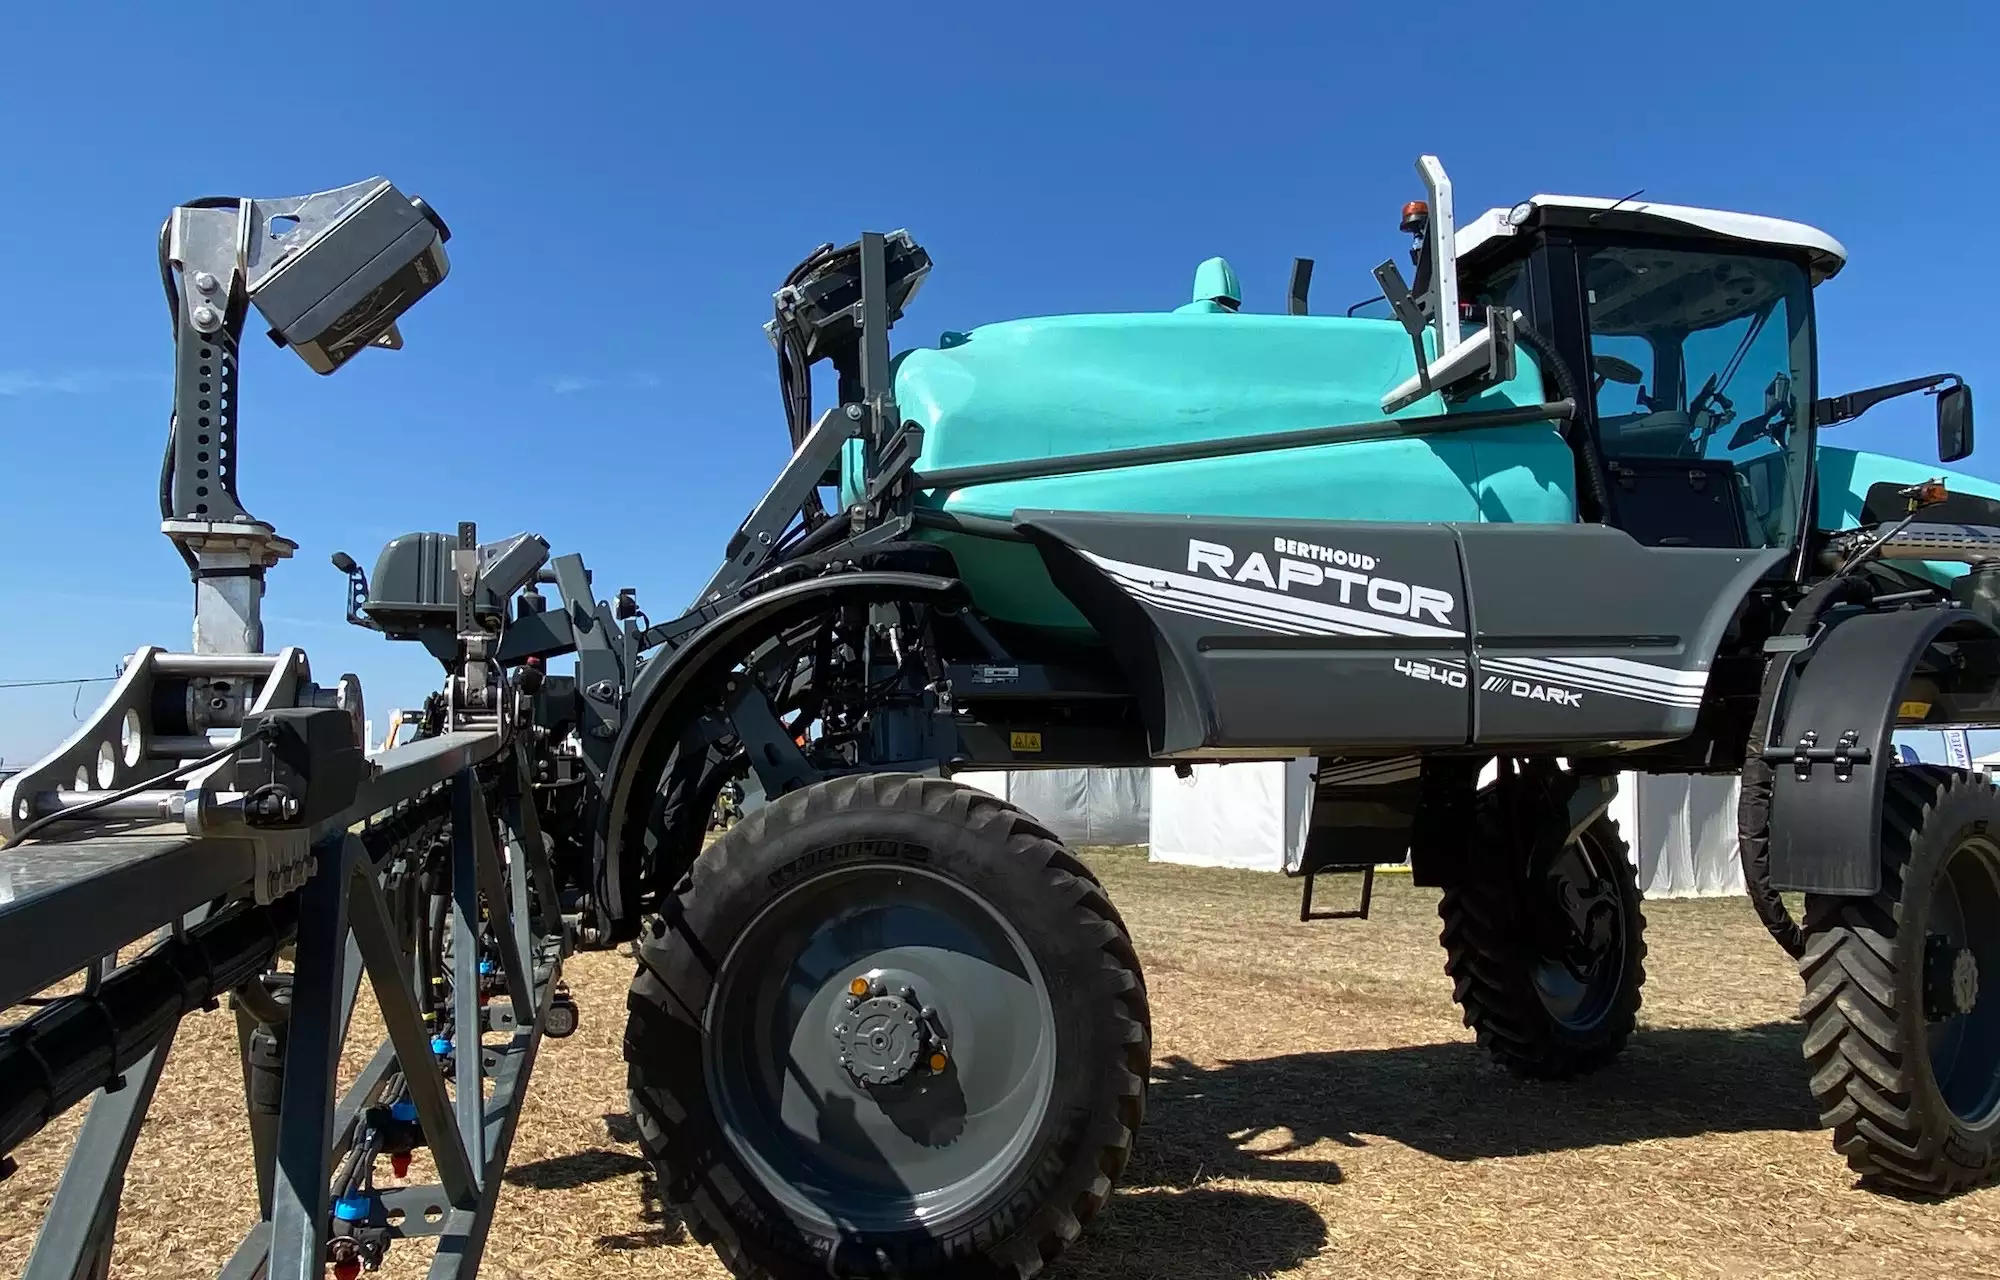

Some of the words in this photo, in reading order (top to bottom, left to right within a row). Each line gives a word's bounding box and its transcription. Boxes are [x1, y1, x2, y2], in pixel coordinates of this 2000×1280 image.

[1274, 537, 1376, 571] BERTHOUD
[1187, 538, 1454, 625] RAPTOR
[1394, 657, 1467, 689] 4240
[1511, 680, 1583, 708] DARK
